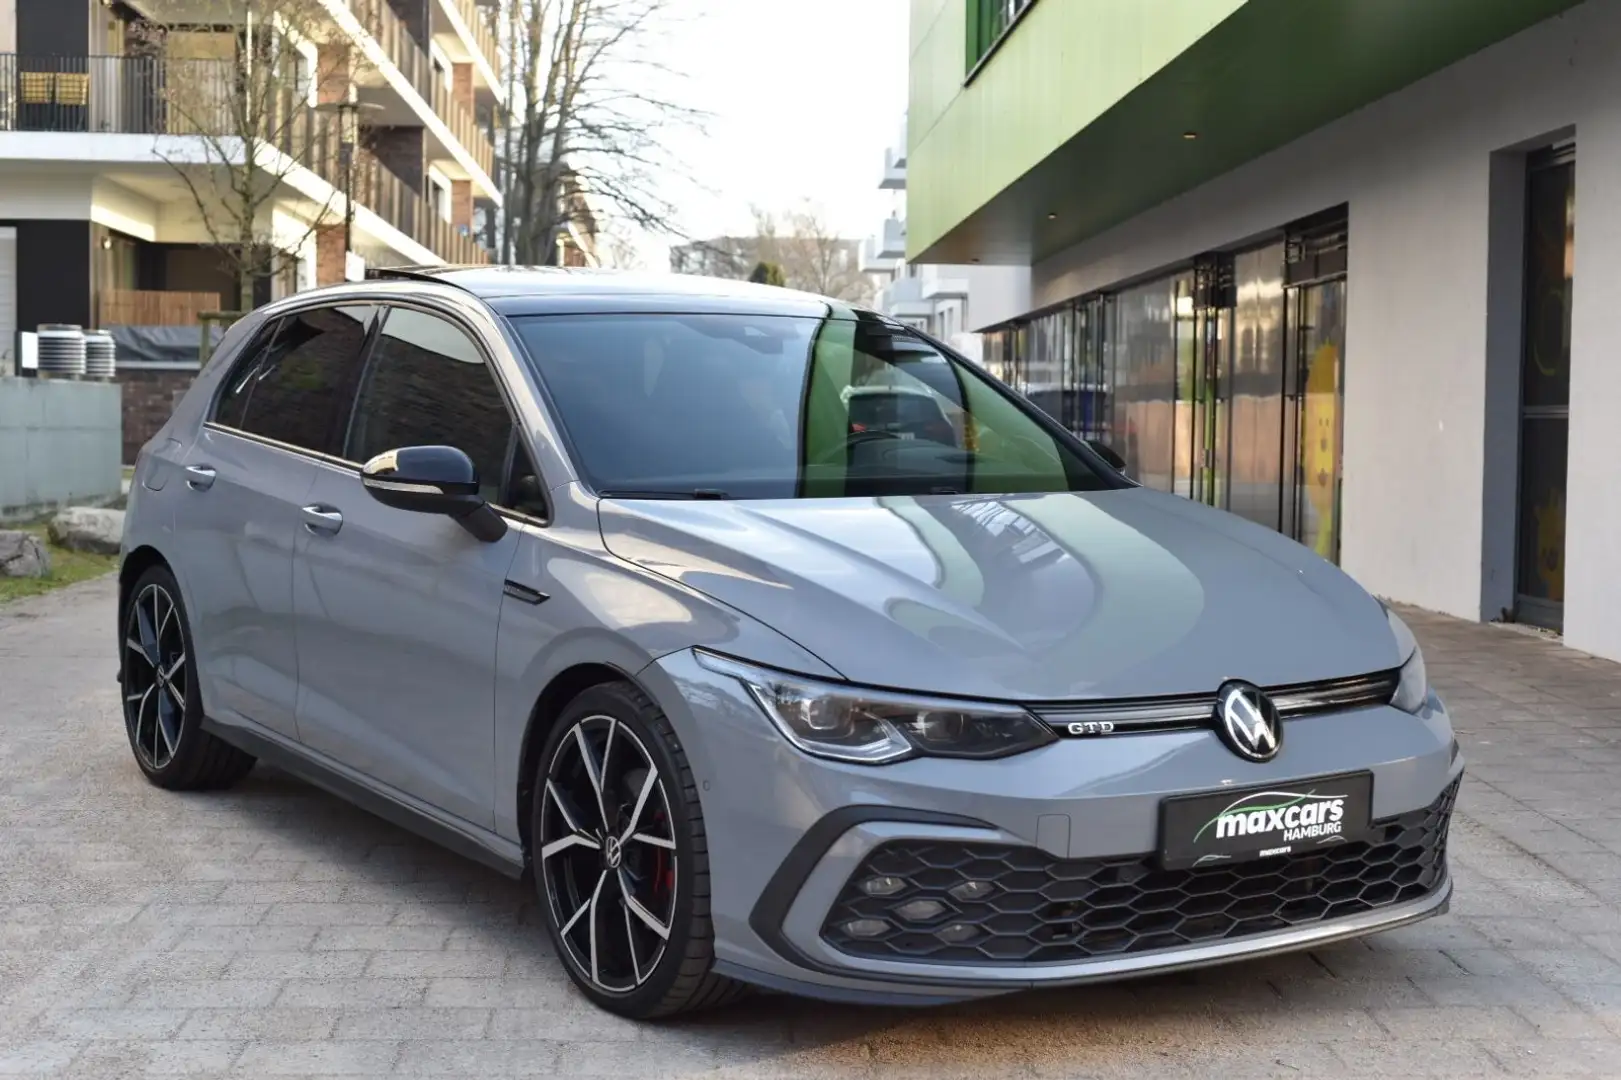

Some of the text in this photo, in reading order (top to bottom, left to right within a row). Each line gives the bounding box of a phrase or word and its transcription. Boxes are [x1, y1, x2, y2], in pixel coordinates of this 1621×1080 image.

[1068, 721, 1114, 735] GTD
[1216, 799, 1344, 838] maxcars
[1283, 822, 1342, 841] HAMBURG
